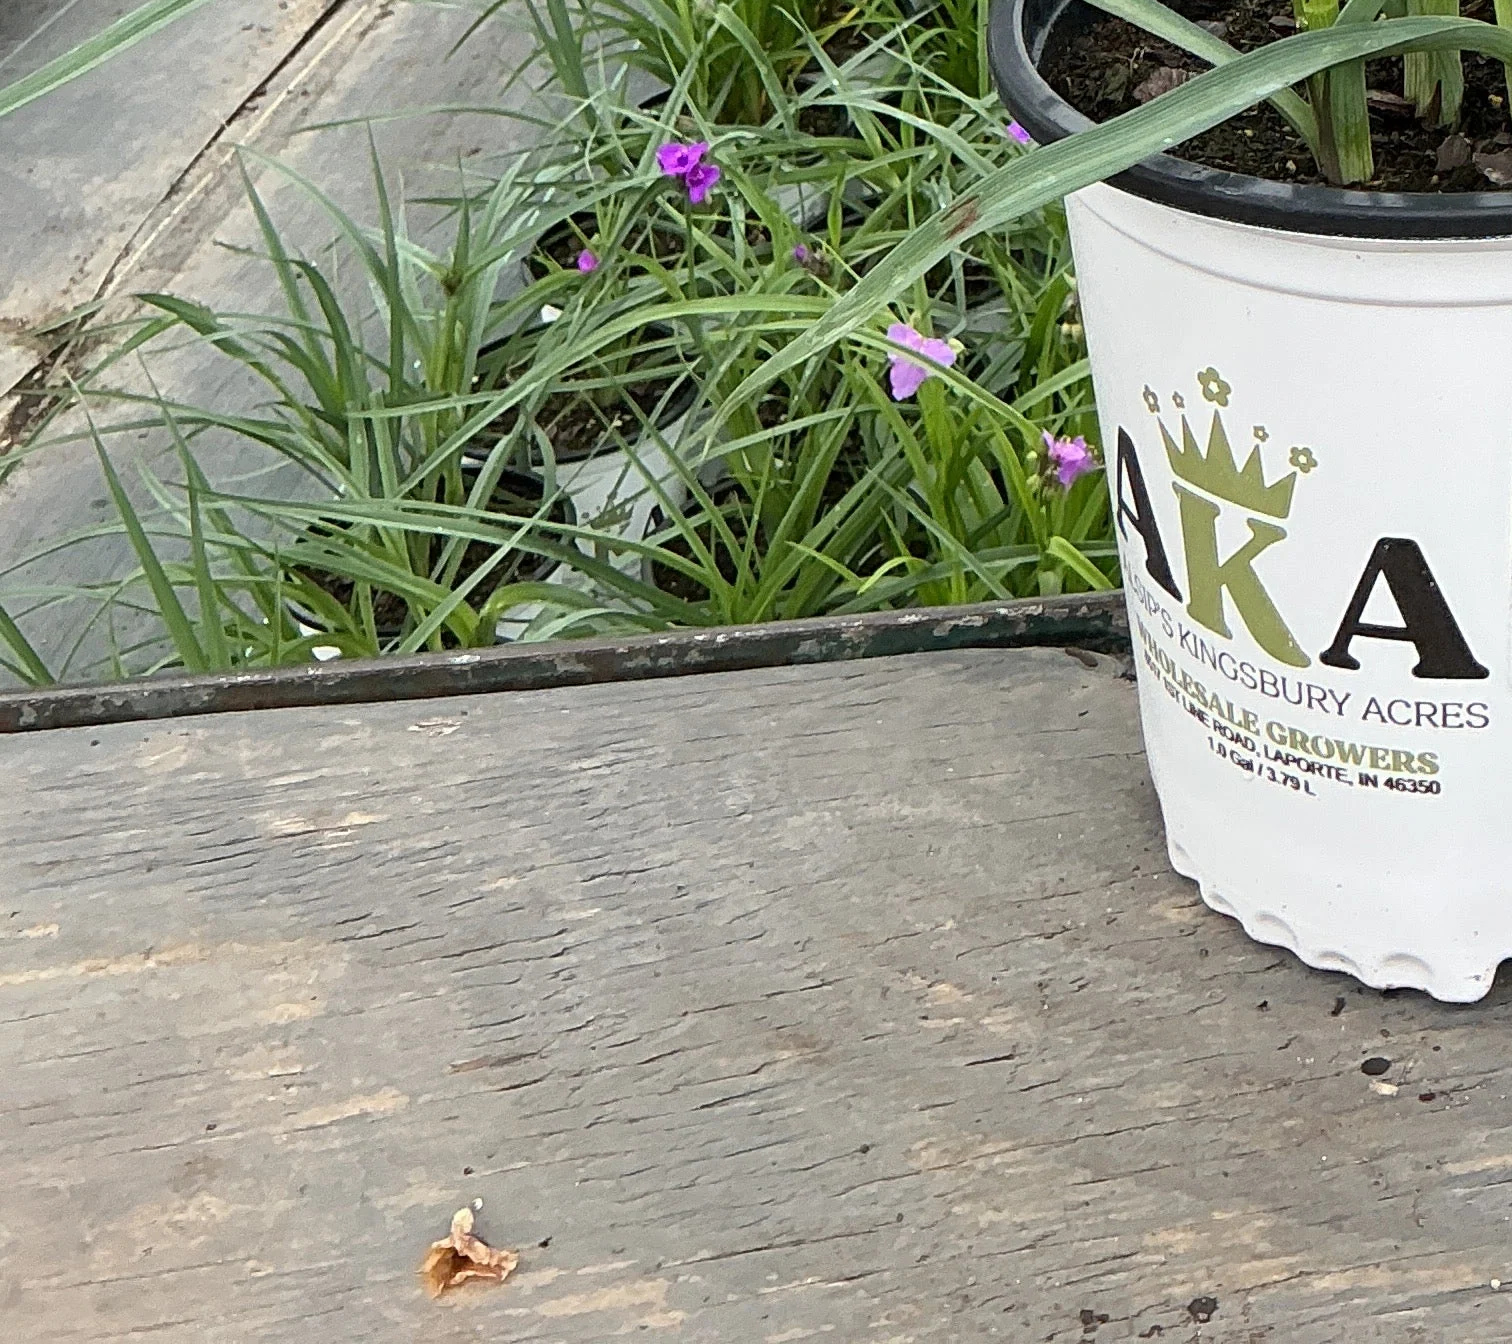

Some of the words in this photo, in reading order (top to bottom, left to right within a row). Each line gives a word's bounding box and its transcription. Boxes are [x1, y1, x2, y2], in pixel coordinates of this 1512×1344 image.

[1117, 425, 1490, 680] AKA
[1136, 613, 1261, 737] WHOLESALE
[1265, 720, 1441, 775] GROWERS
[1178, 621, 1352, 717] KINGSBURY
[1361, 696, 1490, 729] ACRES
[1182, 696, 1211, 730] LINE
[1263, 743, 1355, 787] LAPORTE,
[1358, 771, 1379, 789] IN
[1383, 777, 1442, 795] 46350
[1229, 750, 1255, 772] Gal
[1266, 766, 1301, 792] 3.79
[1303, 779, 1318, 797] L
